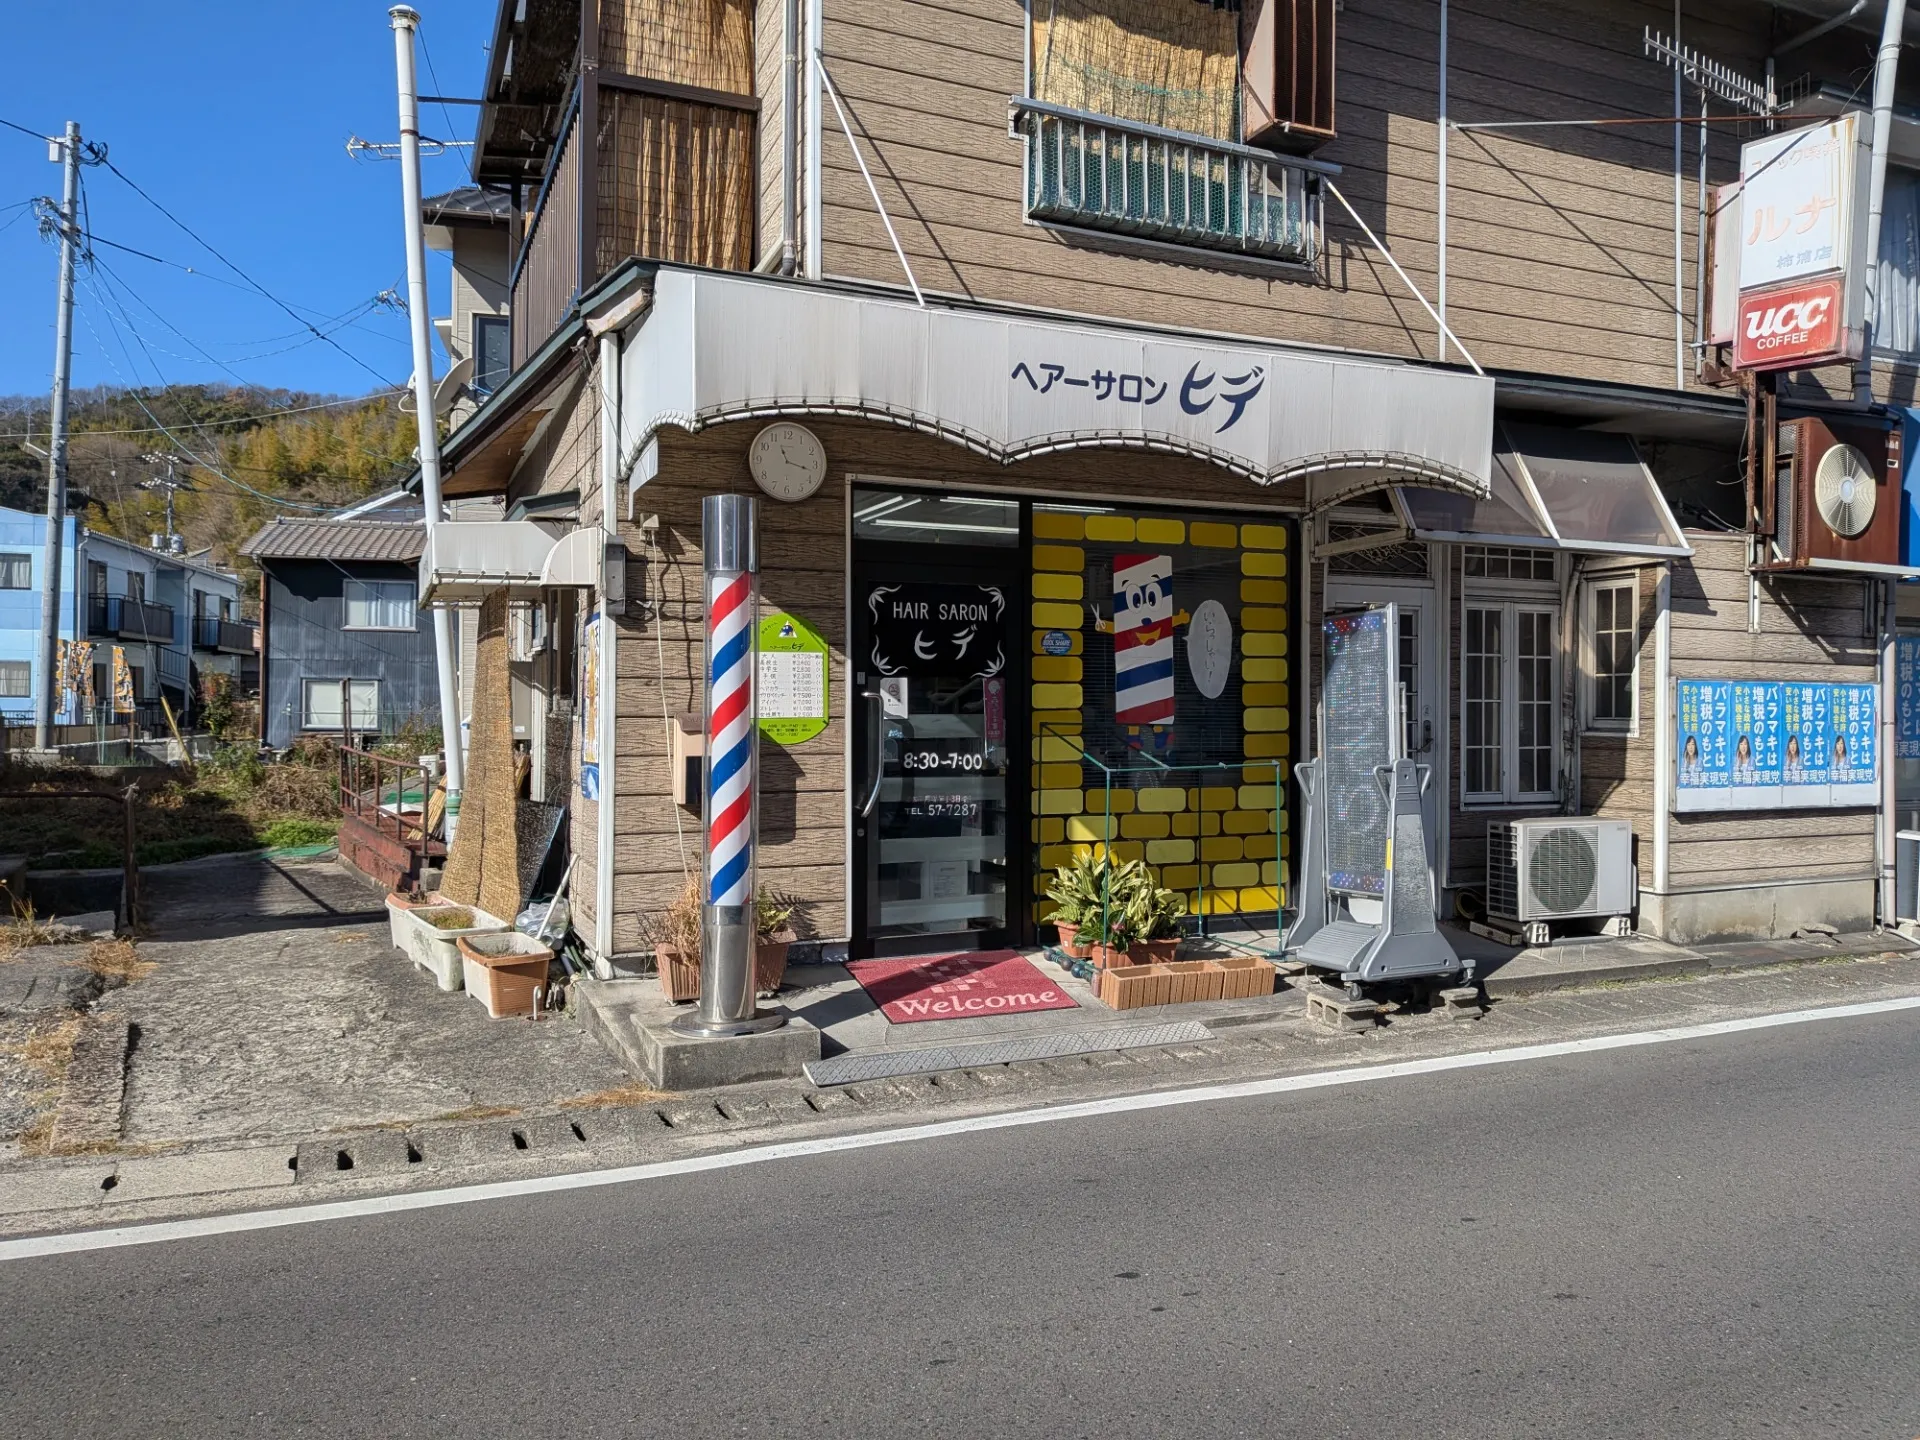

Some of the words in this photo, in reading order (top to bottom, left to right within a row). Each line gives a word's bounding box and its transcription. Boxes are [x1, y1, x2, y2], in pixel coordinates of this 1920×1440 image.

[1747, 194, 1836, 246] ルナ
[1757, 331, 1808, 350] COFFEE
[1011, 362, 1168, 406] ヘアーサロン
[1179, 360, 1265, 434] ヒデ
[770, 433, 777, 442] 11
[783, 430, 793, 440] 12
[799, 436, 803, 445] 1
[760, 441, 769, 451] 10
[808, 447, 814, 456] 2
[756, 455, 762, 464] 9
[812, 460, 818, 469] 3
[761, 471, 767, 479] 8
[807, 474, 812, 484] 4
[772, 481, 778, 490] 7
[783, 485, 789, 494] 6
[798, 483, 804, 492] 5
[893, 601, 929, 619] HAIR
[939, 603, 987, 621] SARON
[914, 624, 978, 660] ヒデ
[1700, 685, 1713, 767] 増税のもと
[1714, 685, 1727, 767] バラマキは
[1752, 686, 1765, 767] 増税のもと
[1766, 686, 1778, 766] バラマキは
[1801, 687, 1813, 766] 増税のもと
[1814, 687, 1826, 766] バラマキは
[1848, 688, 1859, 765] 増税のもと
[1860, 687, 1871, 765] バラマキは
[1680, 772, 1729, 785] 幸福実現党
[1732, 770, 1780, 784] 幸福実現党
[1783, 769, 1827, 783] 幸福実現党
[1830, 768, 1873, 782] 幸福実現党
[905, 807, 922, 815] TEL
[928, 804, 977, 816] 57-7287
[892, 990, 1058, 1016] Welcome
